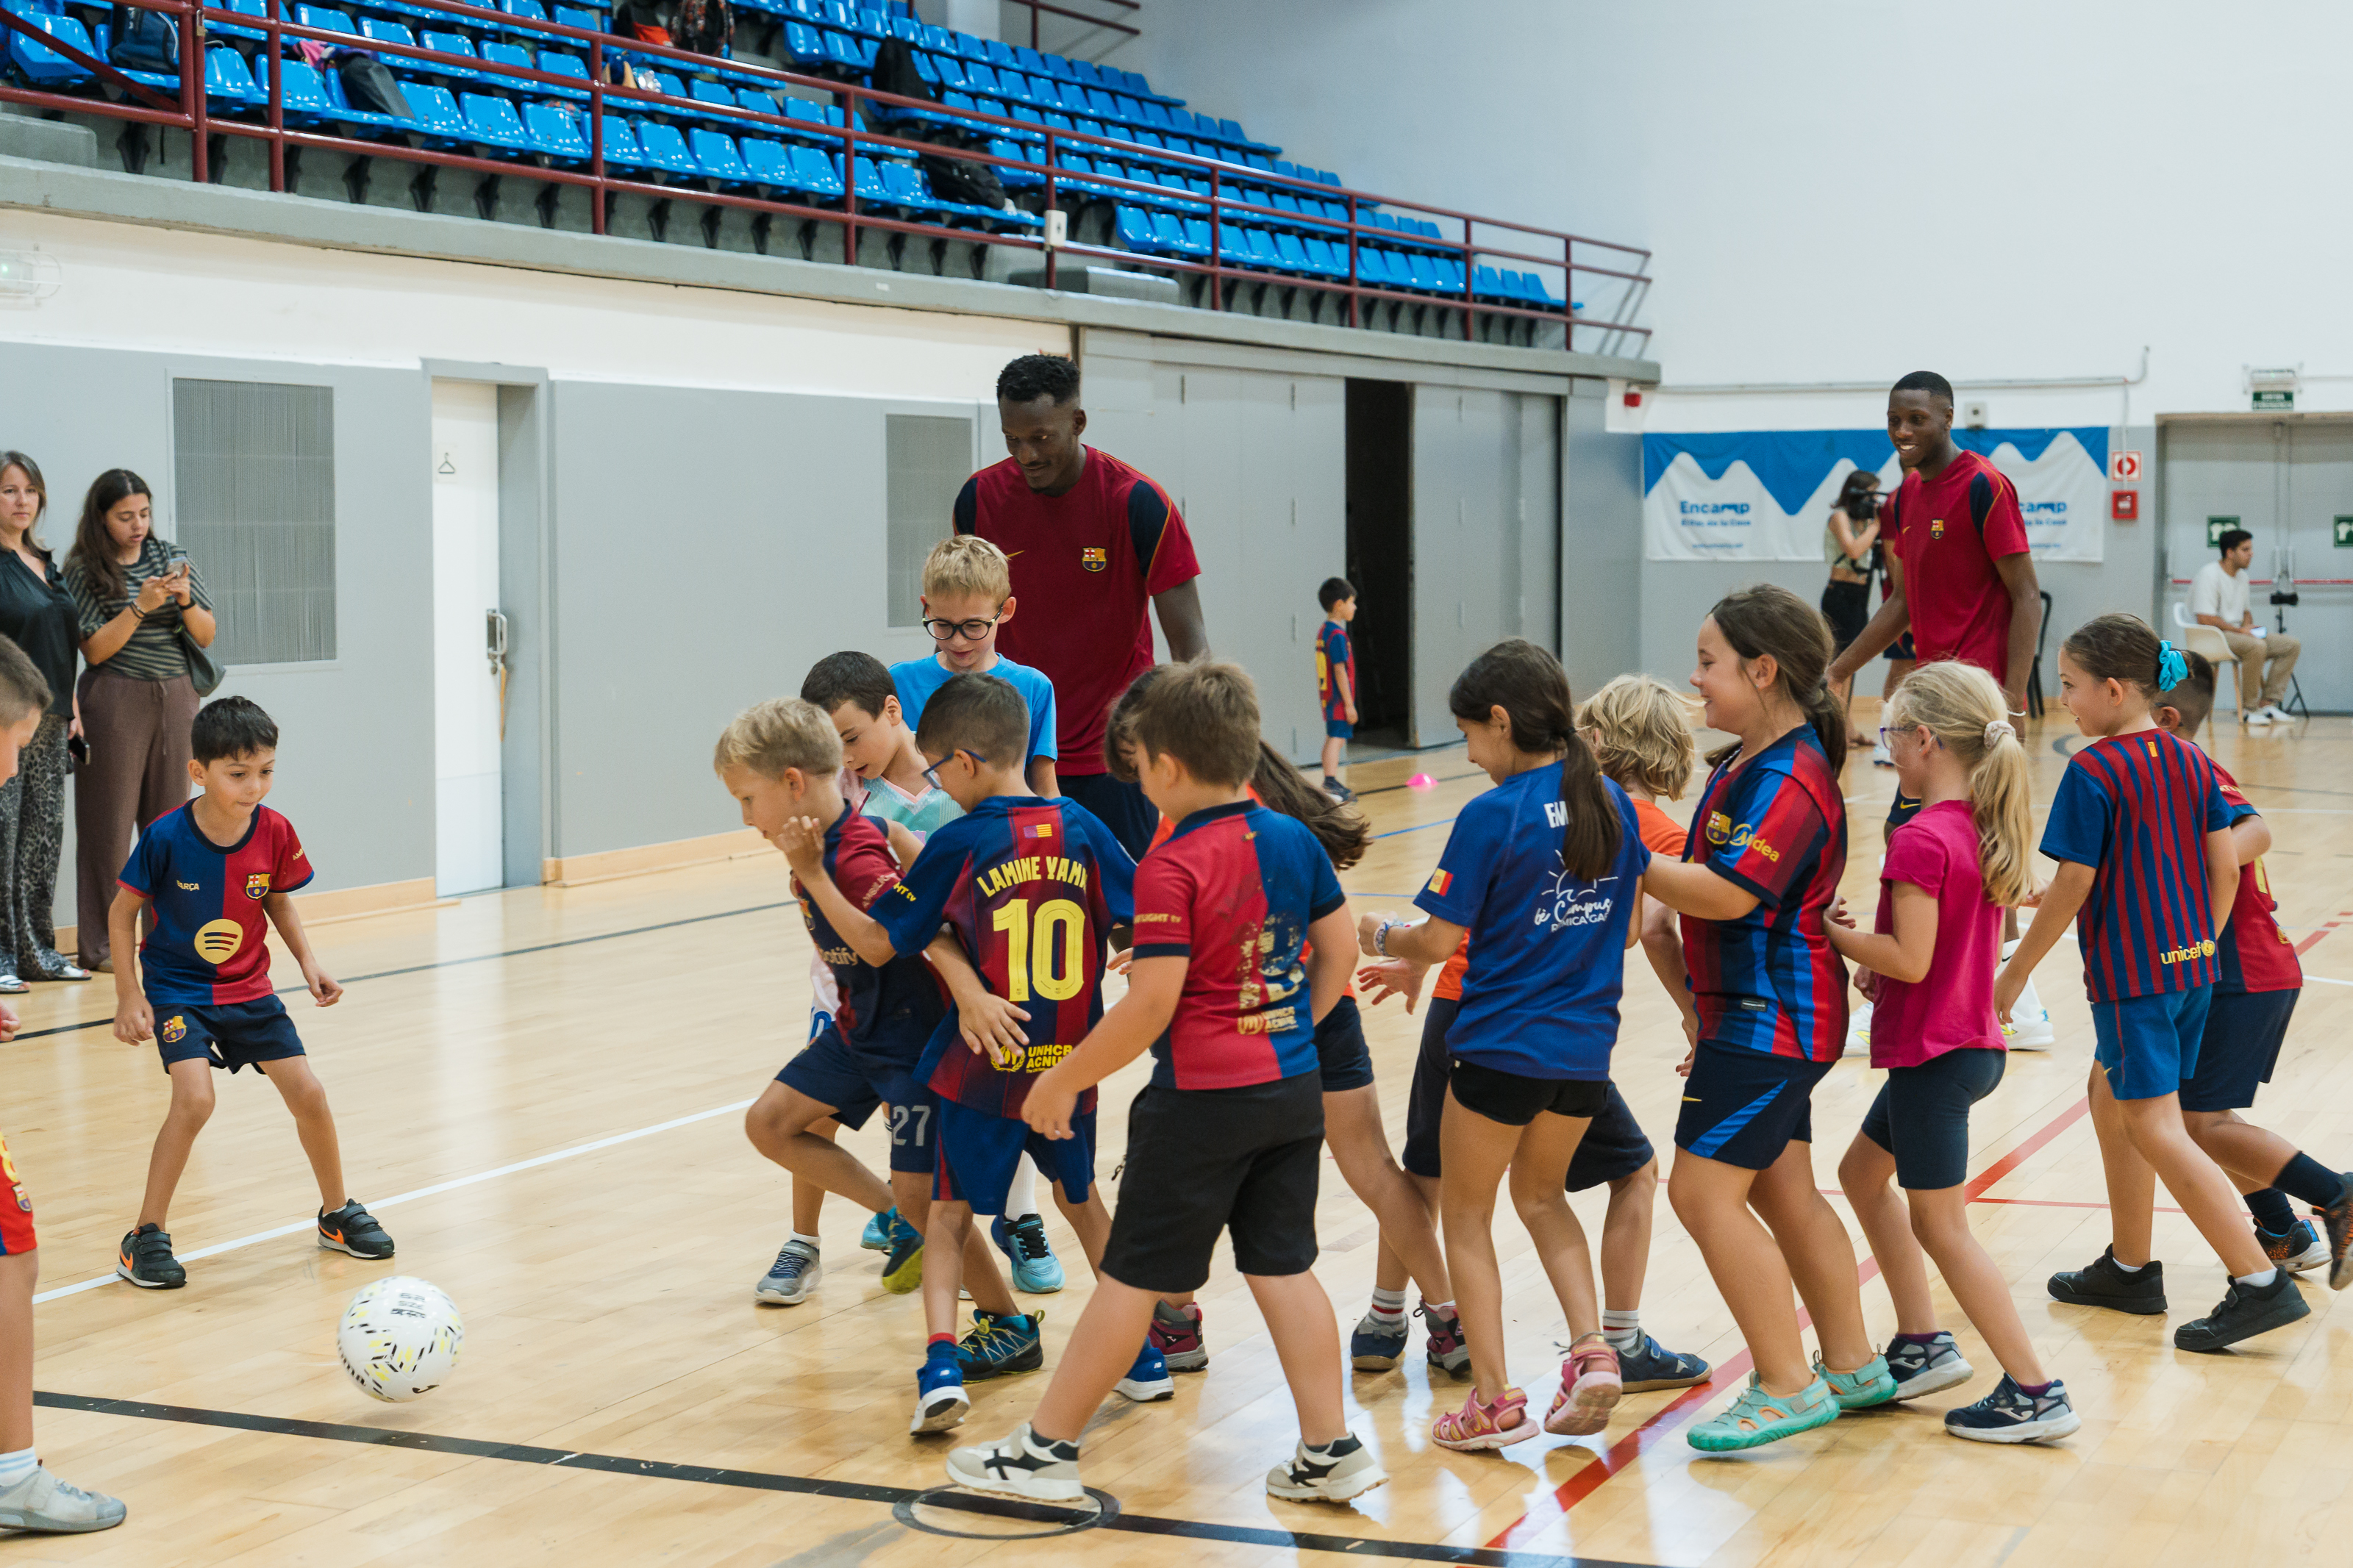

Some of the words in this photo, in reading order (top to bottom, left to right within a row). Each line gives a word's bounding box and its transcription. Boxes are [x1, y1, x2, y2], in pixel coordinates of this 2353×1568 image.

[976, 856, 1042, 898] LAMINE
[993, 898, 1085, 1001] 10
[2160, 941, 2202, 964] unicef
[1026, 1056, 1063, 1069] ACNU
[893, 1105, 931, 1147] 27
